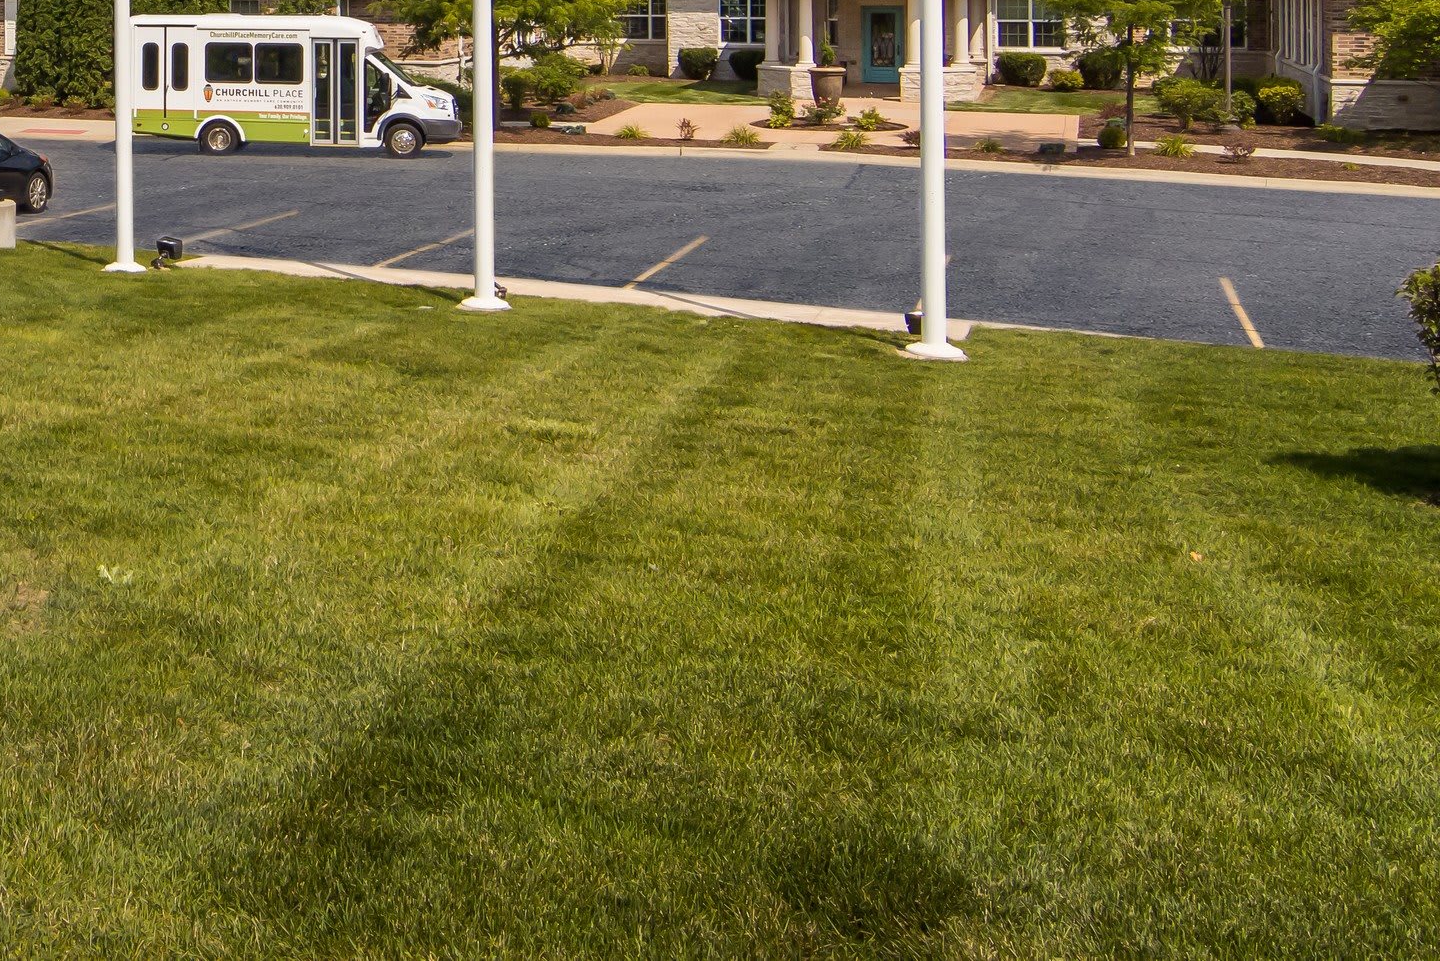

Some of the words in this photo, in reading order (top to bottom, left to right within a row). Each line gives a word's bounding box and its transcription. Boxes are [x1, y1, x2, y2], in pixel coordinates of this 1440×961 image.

[209, 31, 298, 40] ChurchillPlaceMemoryCare.com
[215, 88, 270, 97] CHURCHILL
[272, 89, 304, 98] PLACE
